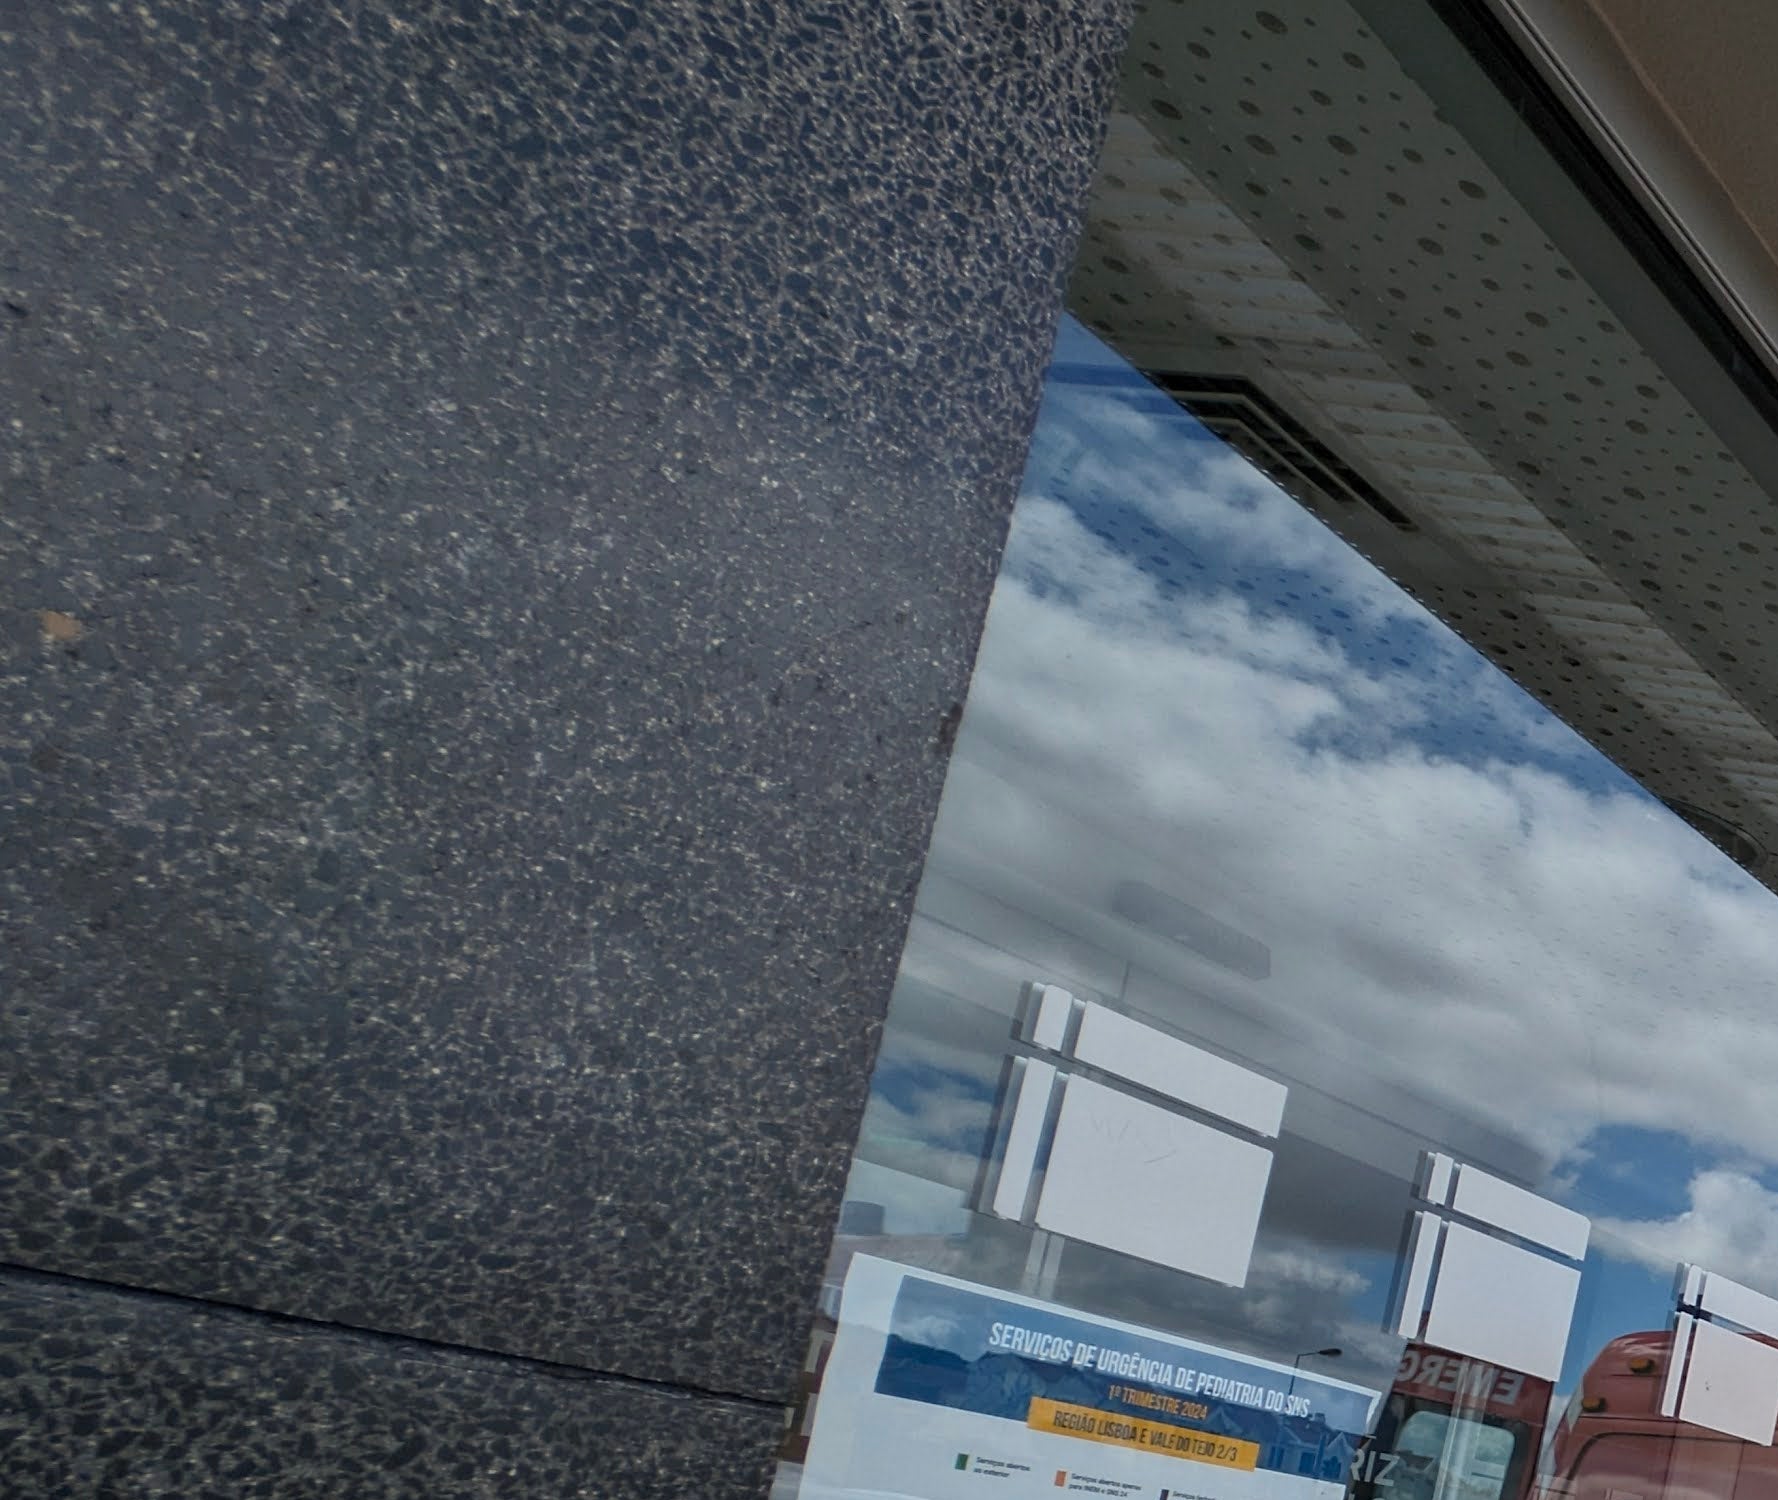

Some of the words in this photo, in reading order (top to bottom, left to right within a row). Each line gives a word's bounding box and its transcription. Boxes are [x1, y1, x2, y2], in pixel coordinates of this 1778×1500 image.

[989, 1321, 1074, 1365] SERVIÇOS
[1073, 1342, 1094, 1368] DE
[1095, 1347, 1174, 1389] URGÊNCIA
[1174, 1363, 1195, 1391] DE
[1196, 1368, 1265, 1409] PEDIATRIA
[1265, 1387, 1284, 1412] DO
[1285, 1392, 1311, 1419] SNS
[1122, 1387, 1181, 1417] TRIMESTRE
[1181, 1399, 1209, 1421] 2024
[1053, 1408, 1094, 1434] REGIÃO
[1097, 1416, 1137, 1442] LISBOA
[1139, 1425, 1148, 1444] E
[1149, 1428, 1175, 1449] VALE
[1175, 1433, 1190, 1451] DO
[1190, 1435, 1215, 1458] TEJO
[1216, 1441, 1238, 1462] 2/3
